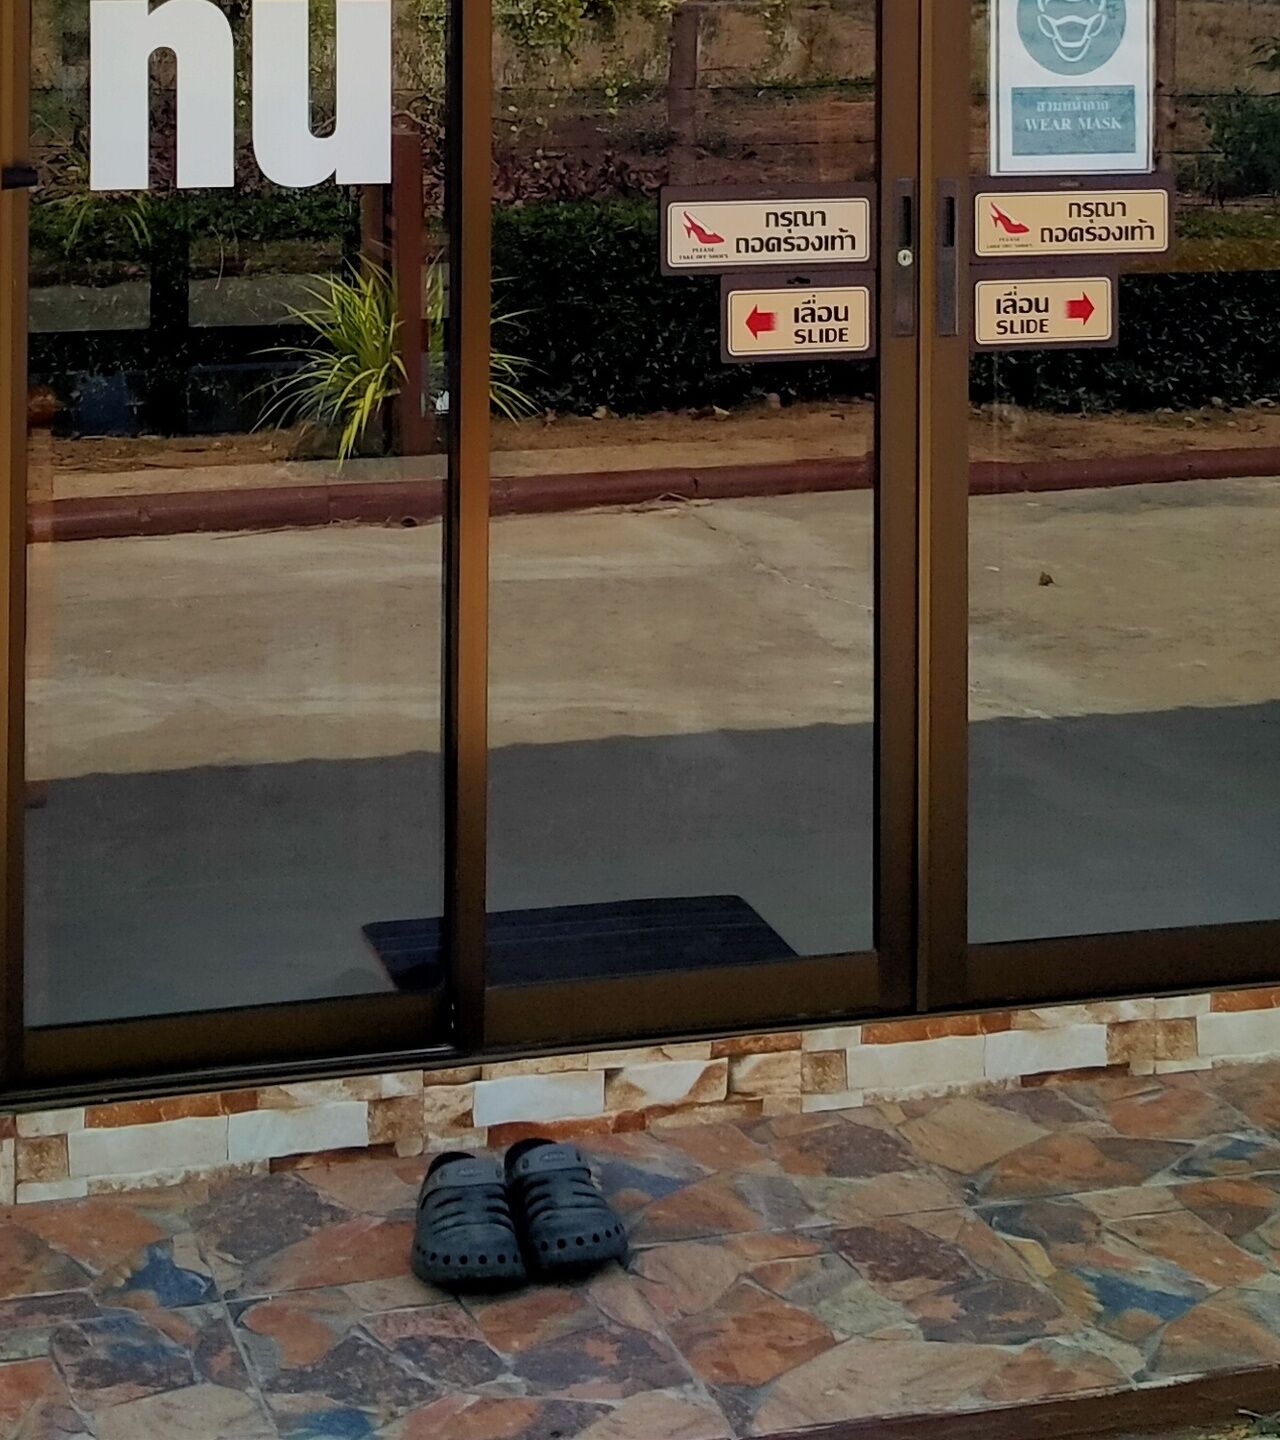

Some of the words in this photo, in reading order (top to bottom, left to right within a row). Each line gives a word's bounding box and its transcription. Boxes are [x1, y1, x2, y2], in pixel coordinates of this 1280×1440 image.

[1025, 117, 1072, 131] WEAR
[1078, 116, 1122, 130] MASK
[765, 210, 827, 234] กรุณา
[1068, 201, 1127, 224] กรุณา
[735, 227, 857, 254] ถอดรองเท้า
[1040, 218, 1155, 243] ถอดรองเท้า
[793, 294, 849, 324] เลื่อน
[995, 285, 1049, 315] เลื่อน
[793, 327, 849, 344] SLIDE
[995, 318, 1050, 335] SLIDE
